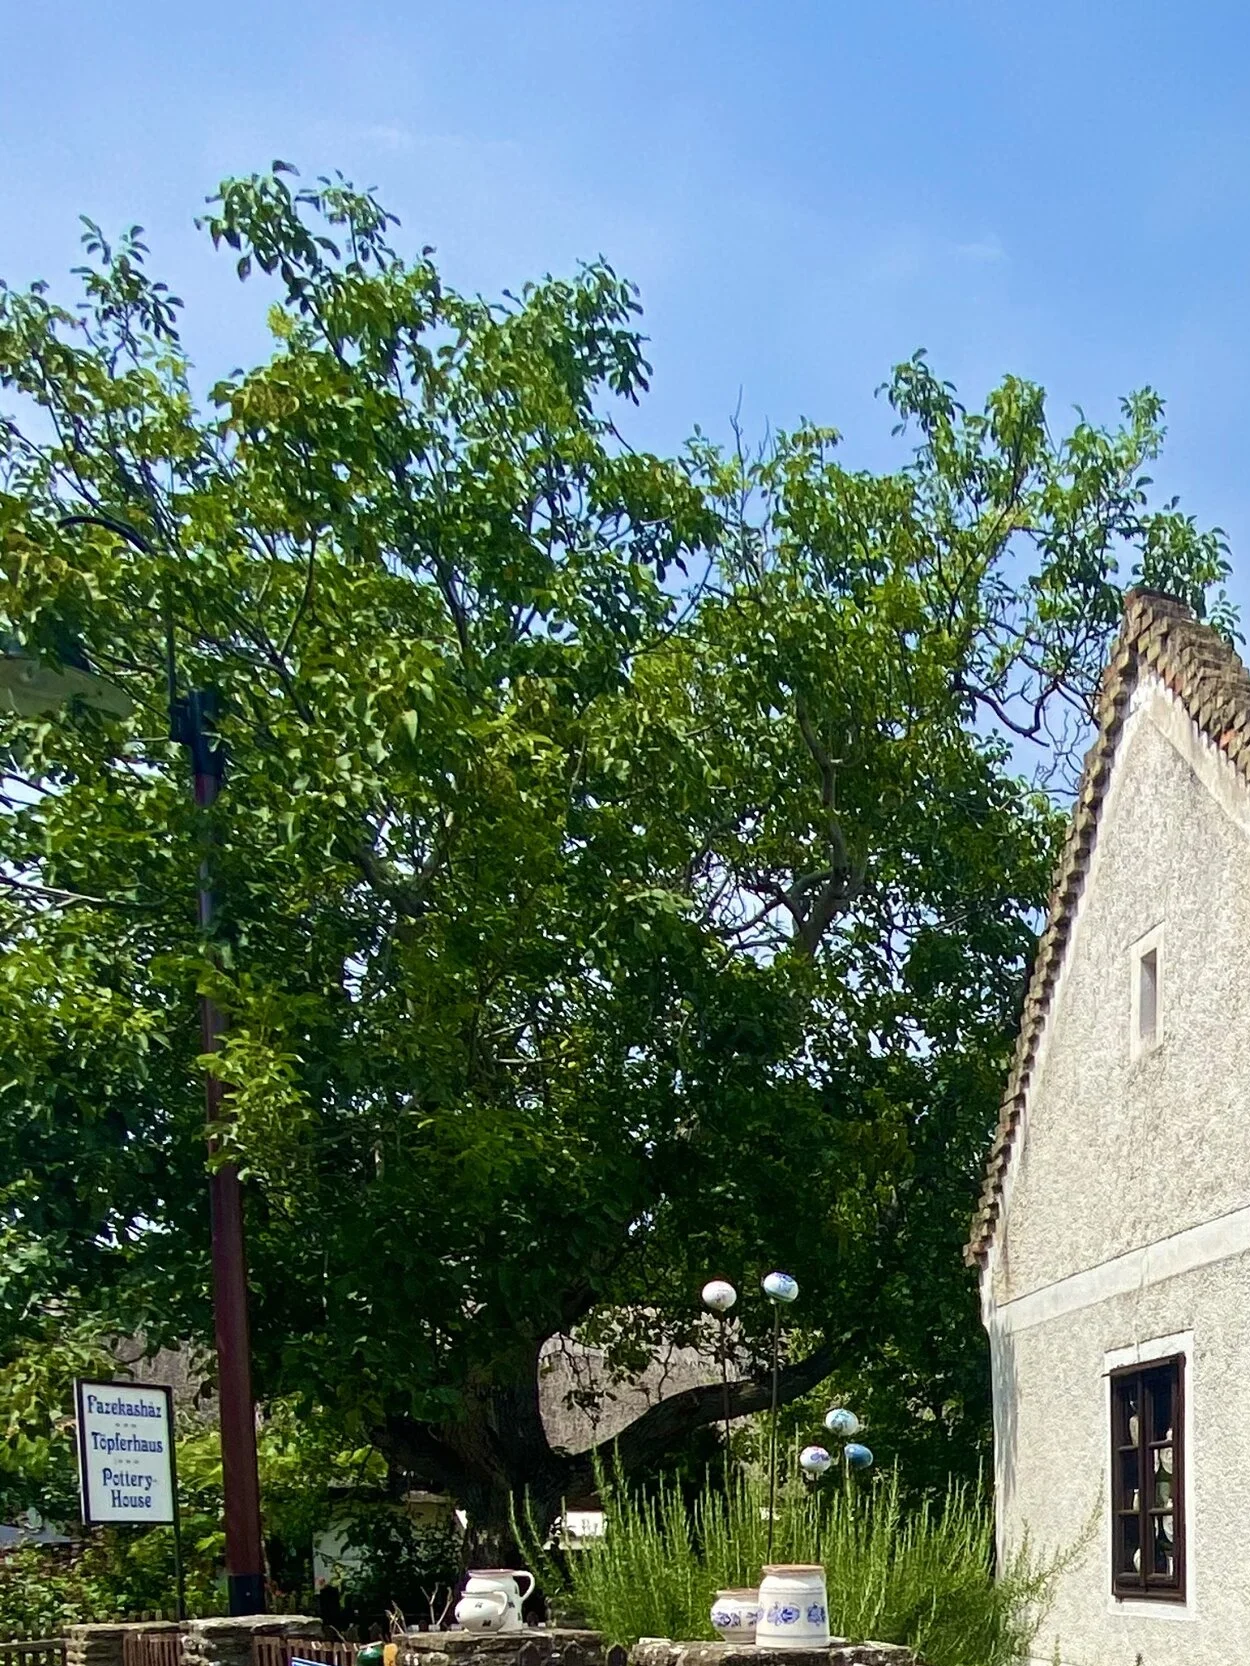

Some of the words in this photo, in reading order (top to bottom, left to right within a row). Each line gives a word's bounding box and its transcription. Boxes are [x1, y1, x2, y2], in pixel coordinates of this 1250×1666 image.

[91, 1431, 163, 1454] Töpferhaus
[102, 1468, 157, 1491] Pottery-
[111, 1489, 151, 1508] House
